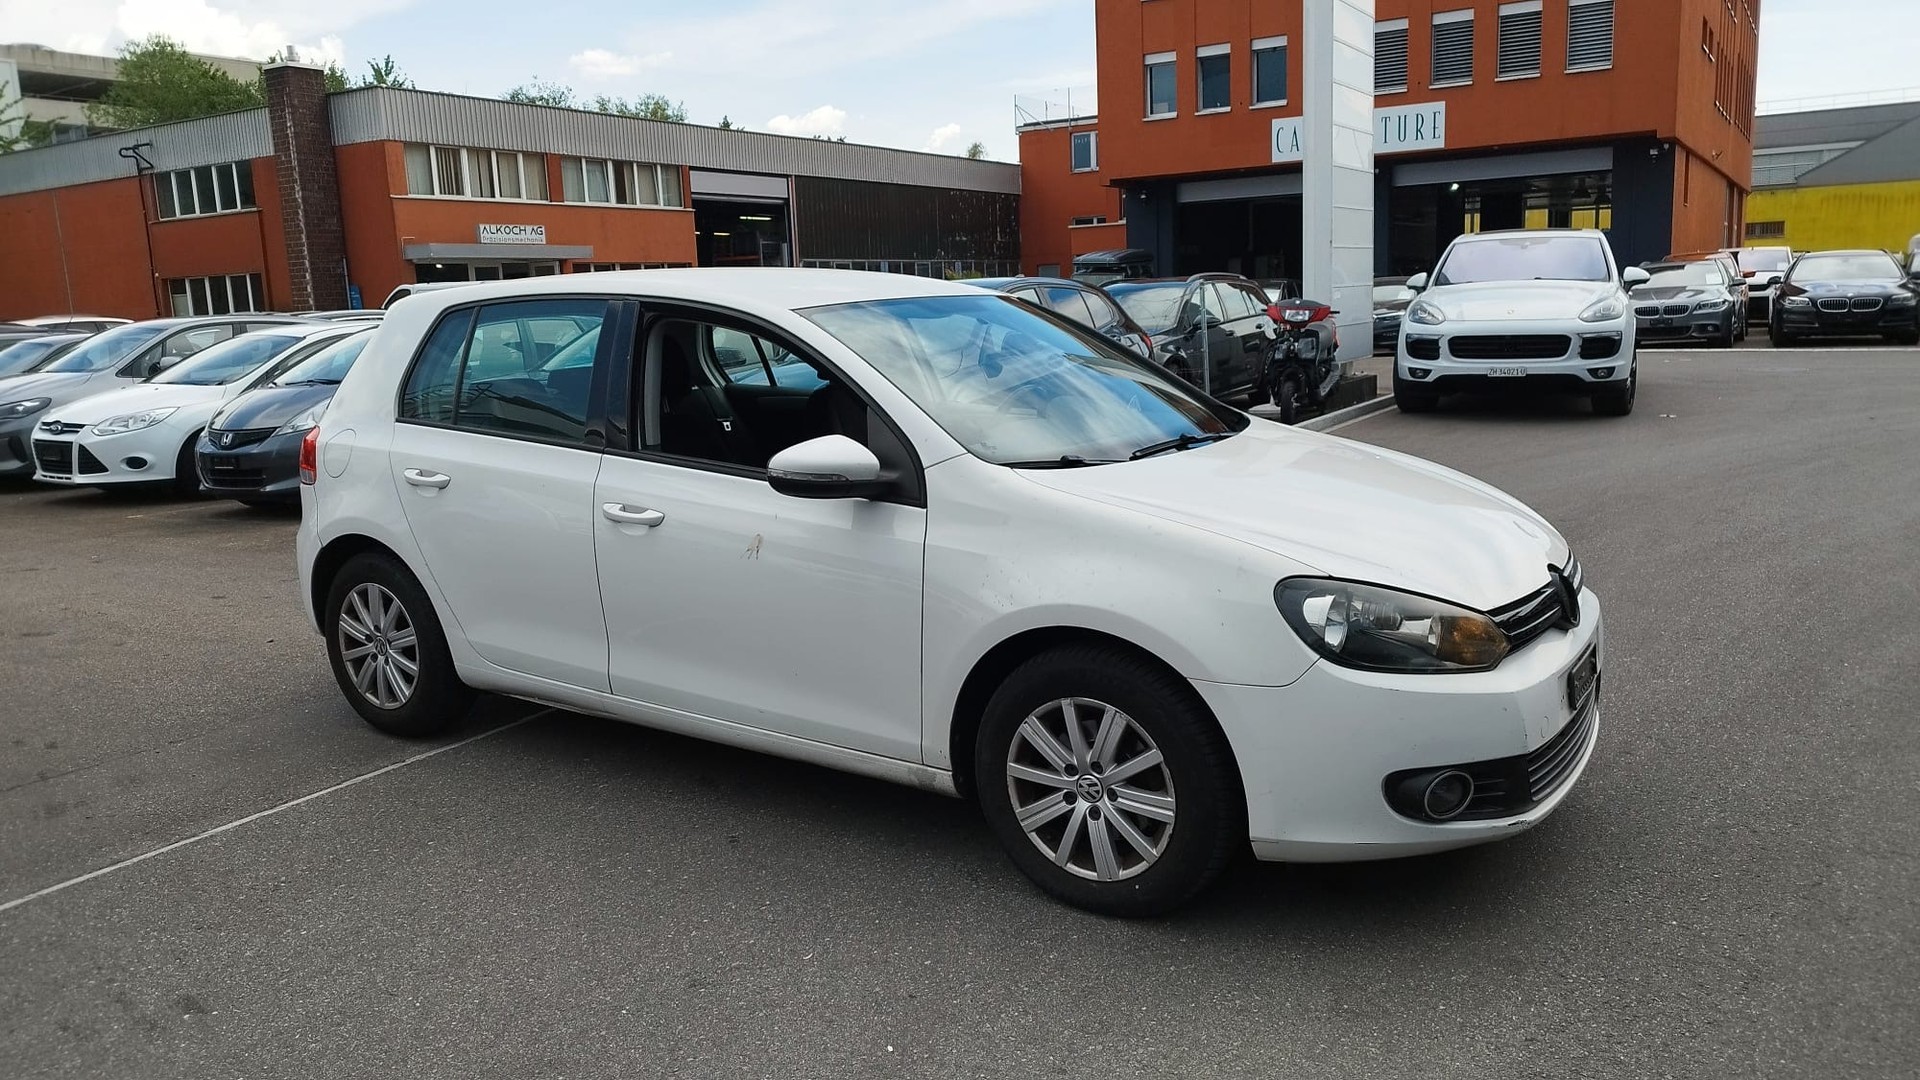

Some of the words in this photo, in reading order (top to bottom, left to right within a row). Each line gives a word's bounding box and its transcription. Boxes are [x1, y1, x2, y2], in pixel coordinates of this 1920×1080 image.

[1276, 126, 1300, 153] CA
[1381, 110, 1441, 144] TURE
[482, 225, 527, 235] ALKOCH
[530, 226, 544, 236] AG
